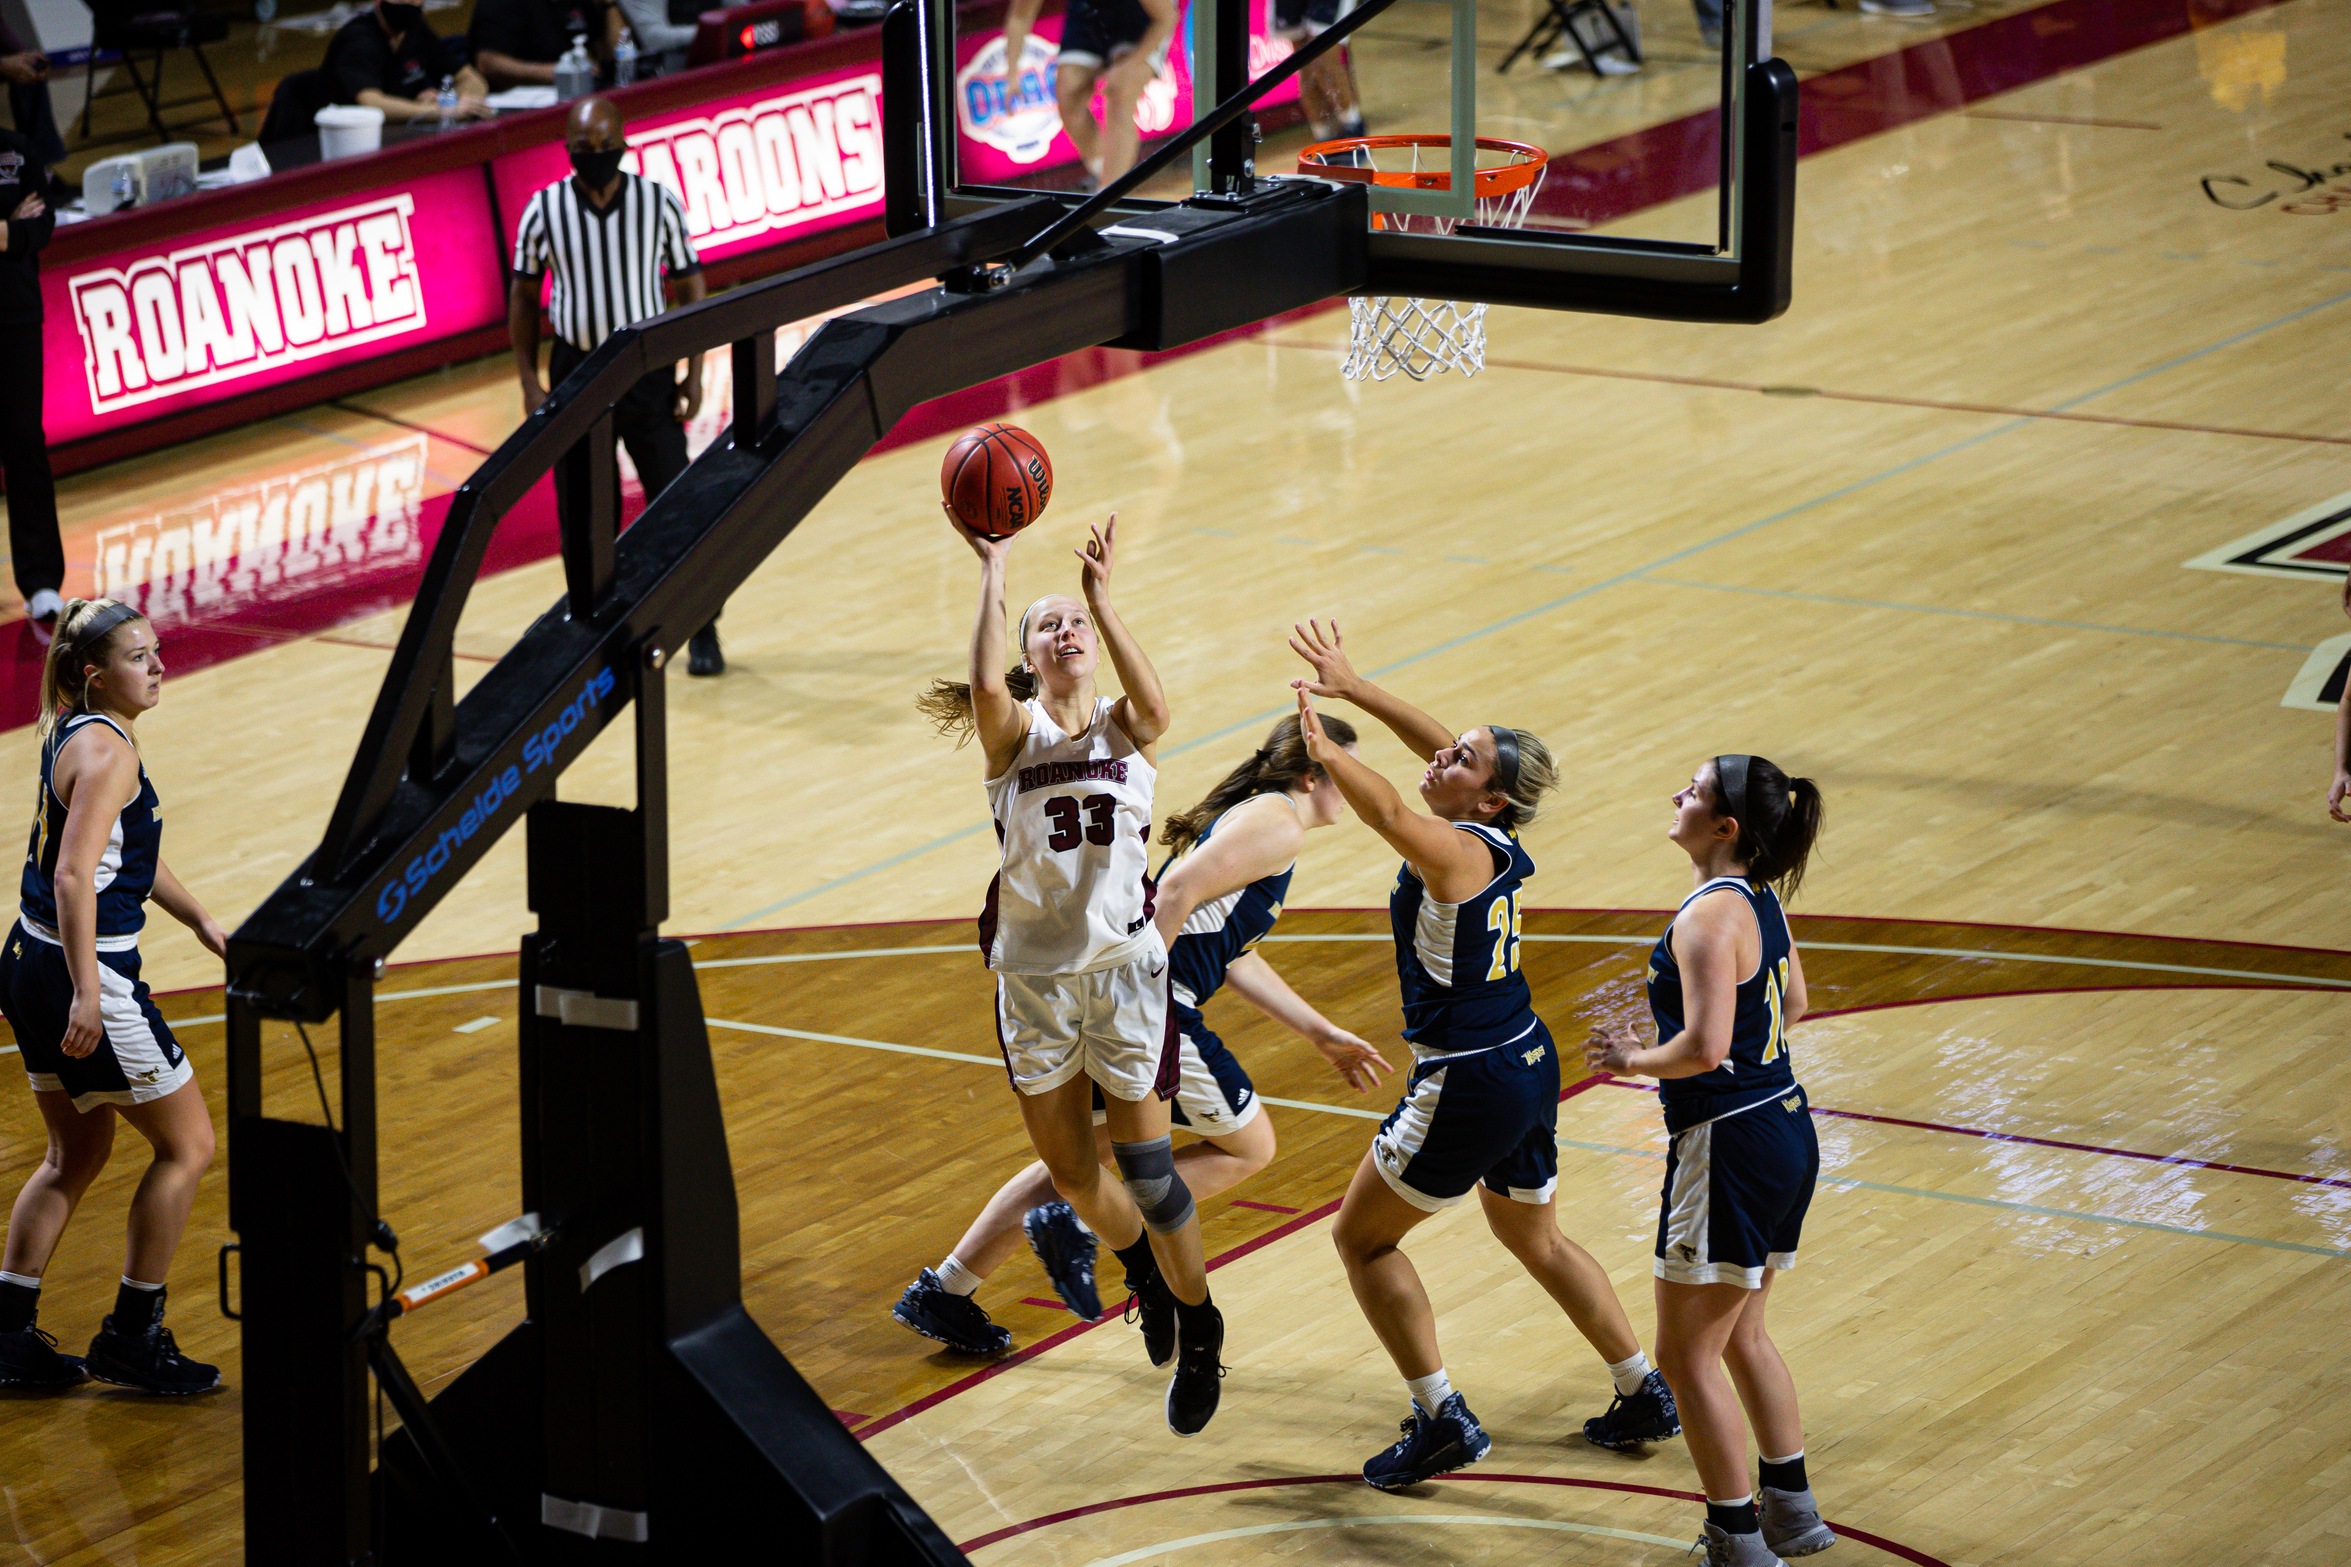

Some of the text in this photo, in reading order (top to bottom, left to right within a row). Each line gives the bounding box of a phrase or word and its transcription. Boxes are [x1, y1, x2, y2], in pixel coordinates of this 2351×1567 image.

[618, 88, 882, 236] AROONS
[78, 208, 420, 400] ROANOKE
[405, 665, 616, 897] Schelde Sports
[1018, 759, 1130, 794] ROANOKE
[1044, 793, 1117, 853] 33
[1485, 887, 1523, 982] 25
